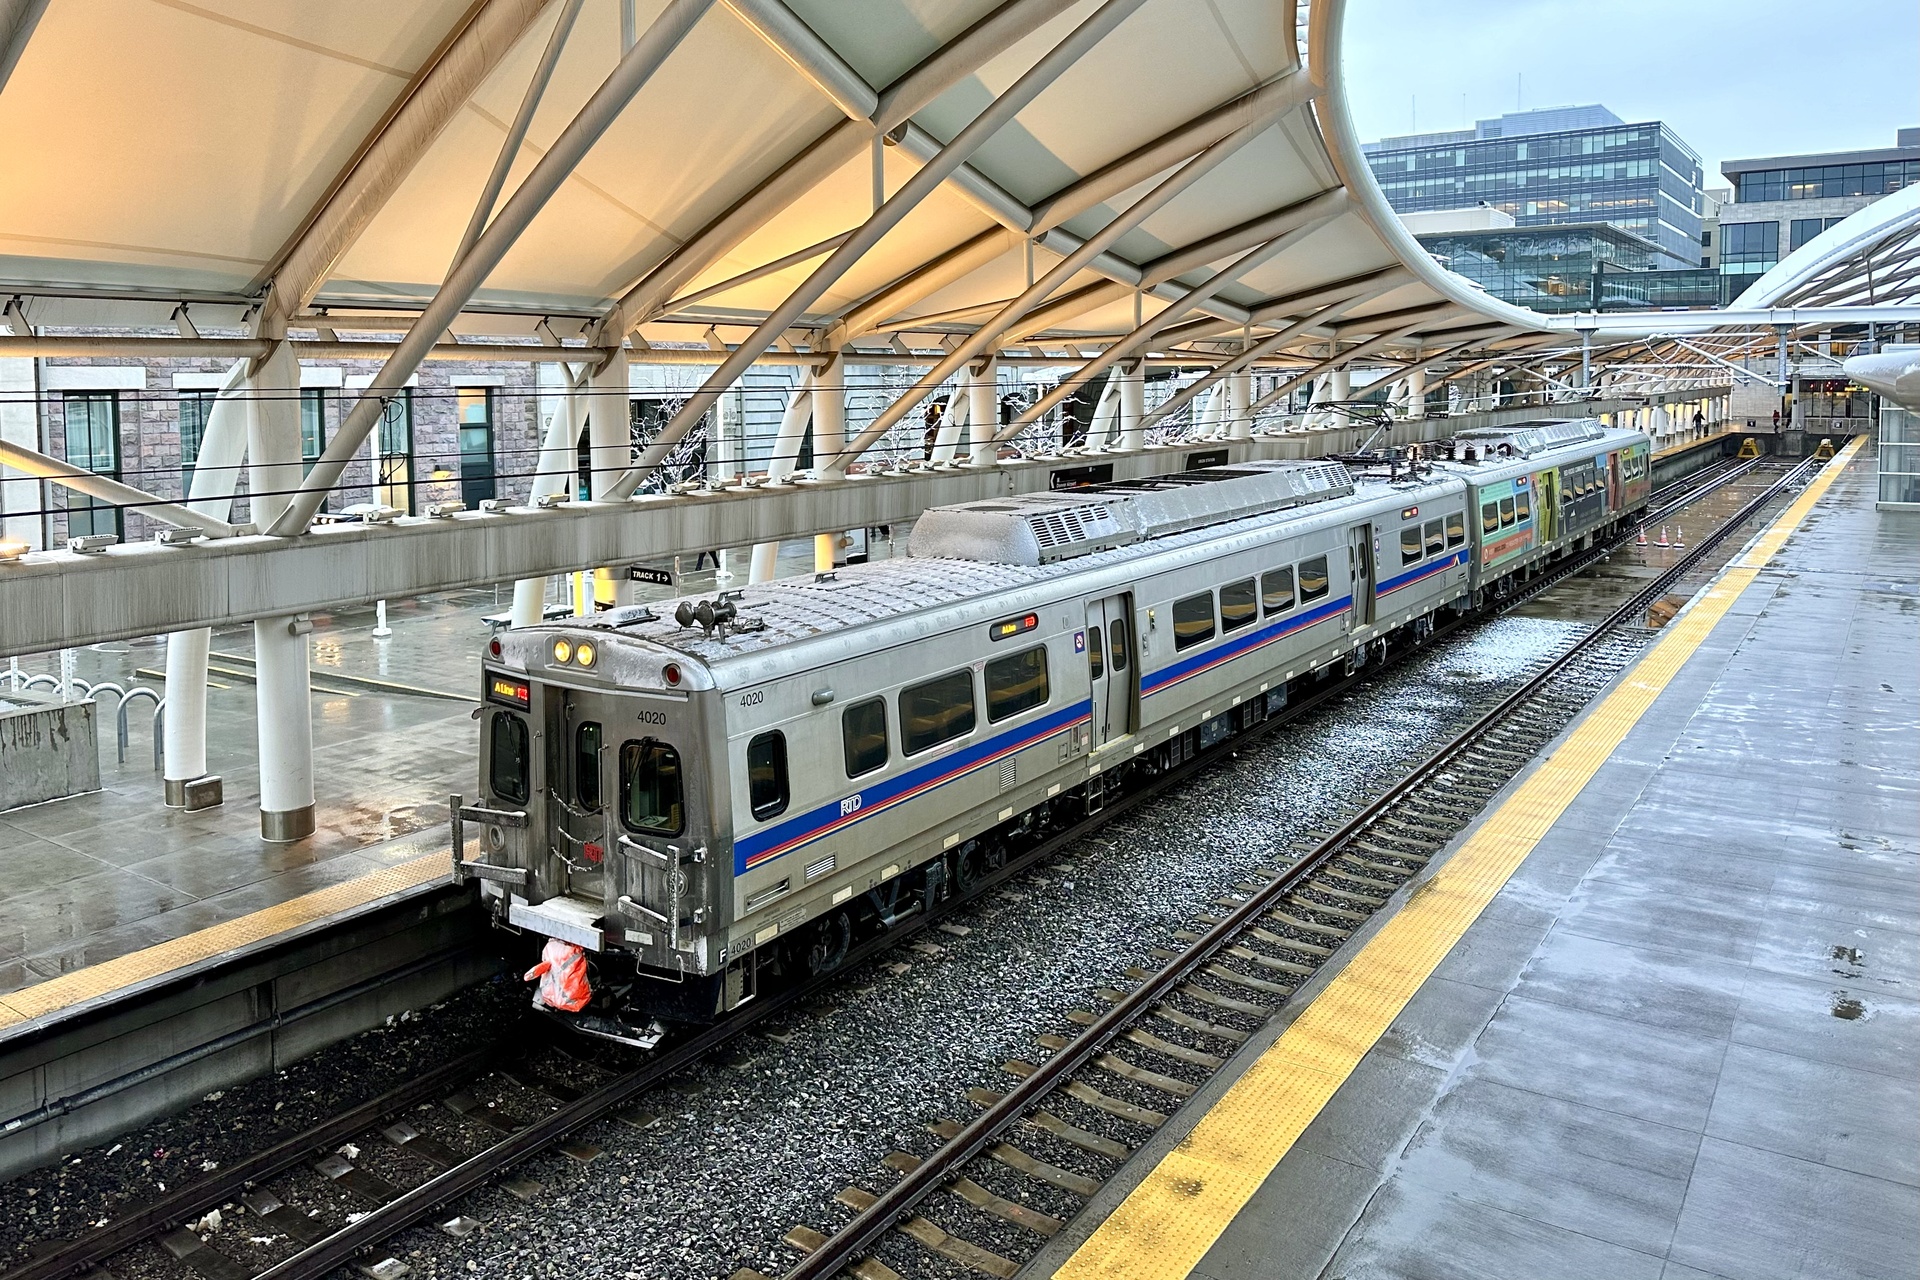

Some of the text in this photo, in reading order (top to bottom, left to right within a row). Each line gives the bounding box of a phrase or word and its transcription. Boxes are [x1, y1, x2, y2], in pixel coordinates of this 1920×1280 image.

[632, 570, 661, 582] TRACK 1
[494, 681, 501, 693] A
[500, 683, 515, 697] Line
[740, 690, 764, 707] 4020
[637, 710, 666, 725] 4020
[840, 794, 862, 816] RTD
[731, 937, 752, 955] 4020
[719, 948, 727, 963] F
